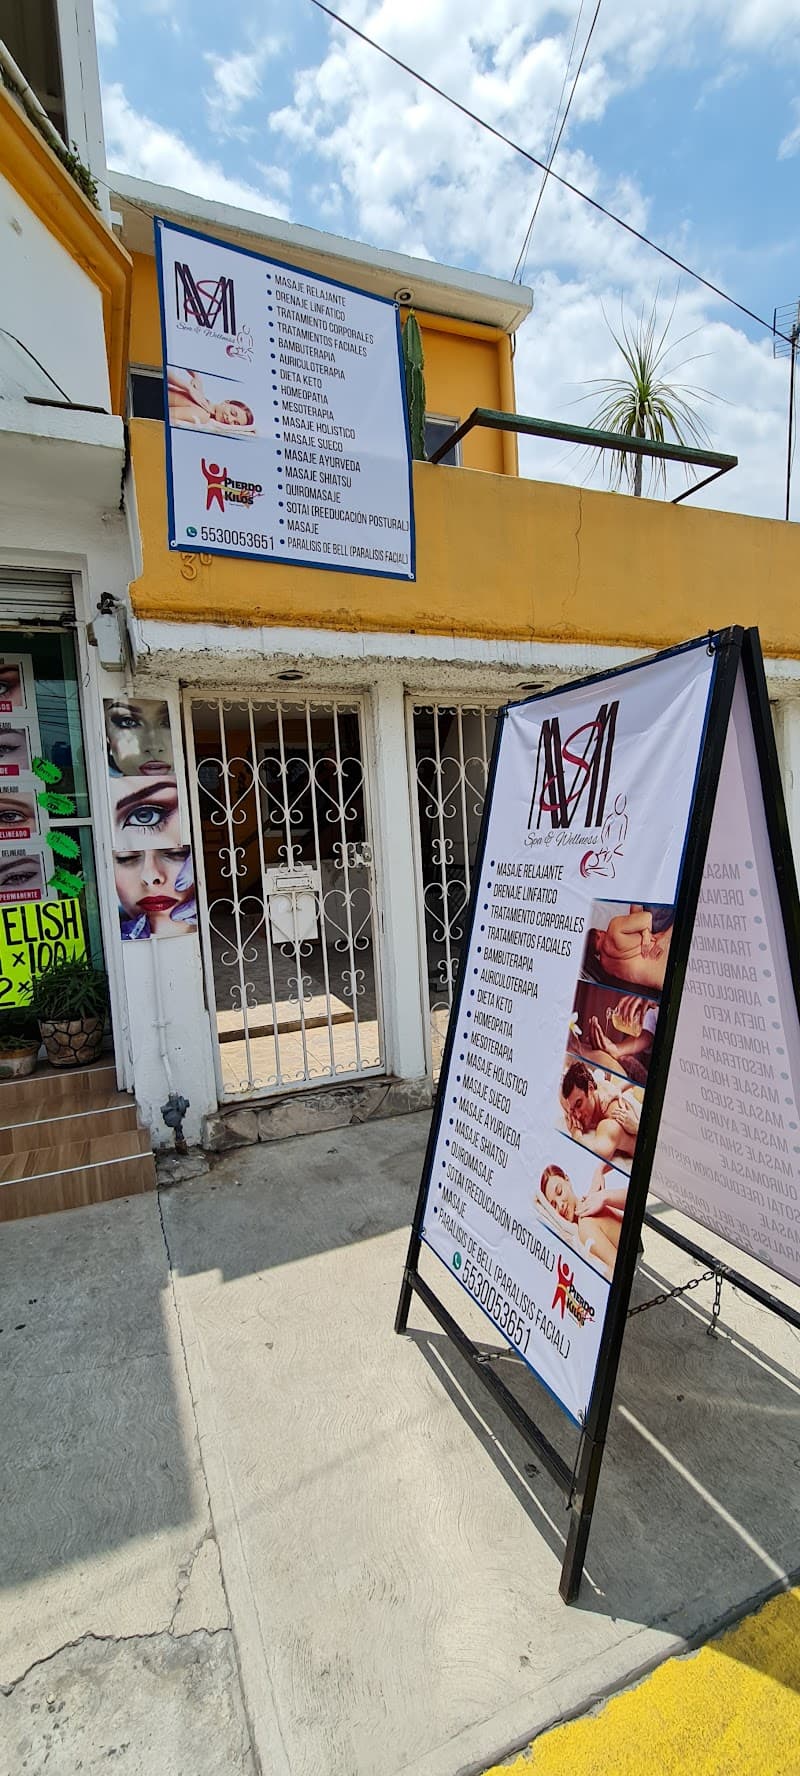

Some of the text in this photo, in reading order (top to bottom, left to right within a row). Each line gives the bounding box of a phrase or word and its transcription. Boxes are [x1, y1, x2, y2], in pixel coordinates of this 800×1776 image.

[275, 274, 346, 307] MASAJE RELAJANTE
[276, 290, 346, 322] DRENAJE LINFATICO
[276, 306, 374, 344] TRATAMIENTO CORPORALES
[277, 322, 368, 357] TRATAMIENTOS FACIALES
[278, 338, 336, 362] BAMBUTERAPIA
[280, 353, 345, 380] AURICULOTERAPIA
[280, 369, 322, 389] DIETA KETO
[281, 385, 328, 405] HOMEOPATIA
[282, 400, 334, 421] MESOTERAPIA
[282, 416, 356, 440] MASAJE HOLISTICO
[283, 431, 343, 453] MASAJE SUECO
[284, 448, 361, 472] MASAJE AYURVEDA
[224, 478, 262, 493] PIERDO
[285, 466, 352, 488] MASAJE SHIATSU
[224, 491, 254, 505] KILOS
[285, 484, 341, 503] QUIROMASAJE
[286, 501, 309, 516] SOTAI
[201, 526, 274, 551] 5530053651
[287, 520, 319, 534] MASAJE
[287, 537, 321, 553] PARALISIS
[323, 542, 331, 554] DE
[332, 544, 348, 557] BELL
[524, 832, 598, 848] Spa & Wellness
[496, 862, 564, 880] MASAJE RELAJANTE
[493, 883, 558, 904] DRENAJE LINFATICO
[491, 904, 584, 934] TRATAMIENTO CORPORALES
[487, 926, 572, 957] TRATAMIENTOS FACIALES
[484, 947, 534, 973] BAMBUTERAPIA
[480, 968, 538, 998] AURICULOTERAPIA
[477, 989, 513, 1014] DIETA KETO
[474, 1010, 513, 1038] HOMEOPATIA
[471, 1031, 513, 1063] MESOTERAPIA
[466, 1052, 528, 1096] MASAJE HOLISTICO
[462, 1074, 511, 1114] MASAJE SUECO
[459, 1096, 521, 1151] MASAJE AYURVEDA
[454, 1119, 509, 1169] MASAJE SHIATSU
[446, 1163, 465, 1185] SOTAI
[450, 1141, 494, 1186] QUIROMASAJE
[442, 1188, 467, 1219] MASAJE
[438, 1208, 468, 1249] PARALISIS
[467, 1237, 478, 1258] DE
[477, 1247, 492, 1277] BELL
[462, 1259, 531, 1354] 5530053651
[569, 1284, 595, 1317] PIERDO
